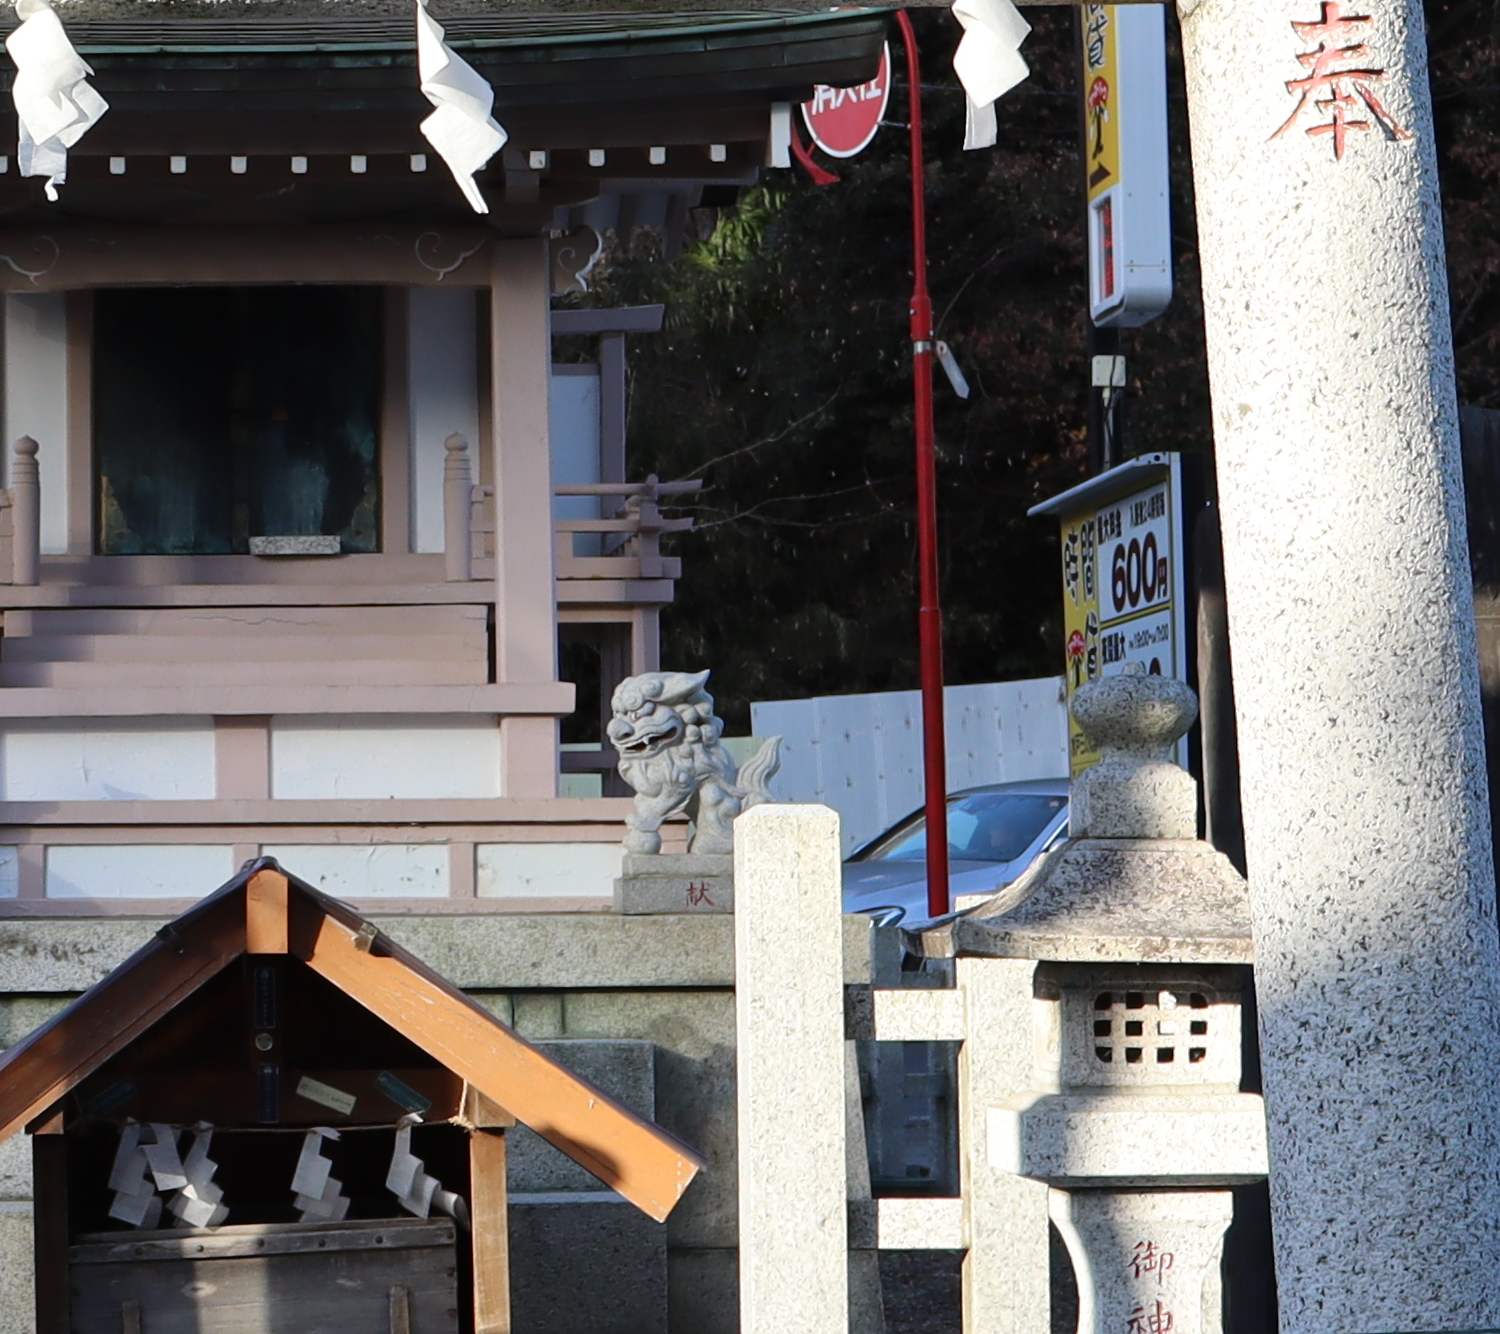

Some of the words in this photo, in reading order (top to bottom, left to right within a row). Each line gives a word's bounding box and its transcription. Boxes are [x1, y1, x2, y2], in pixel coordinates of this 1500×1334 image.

[1267, 0, 1414, 163] 奉
[1111, 531, 1168, 613] 600円
[683, 878, 715, 909] 献
